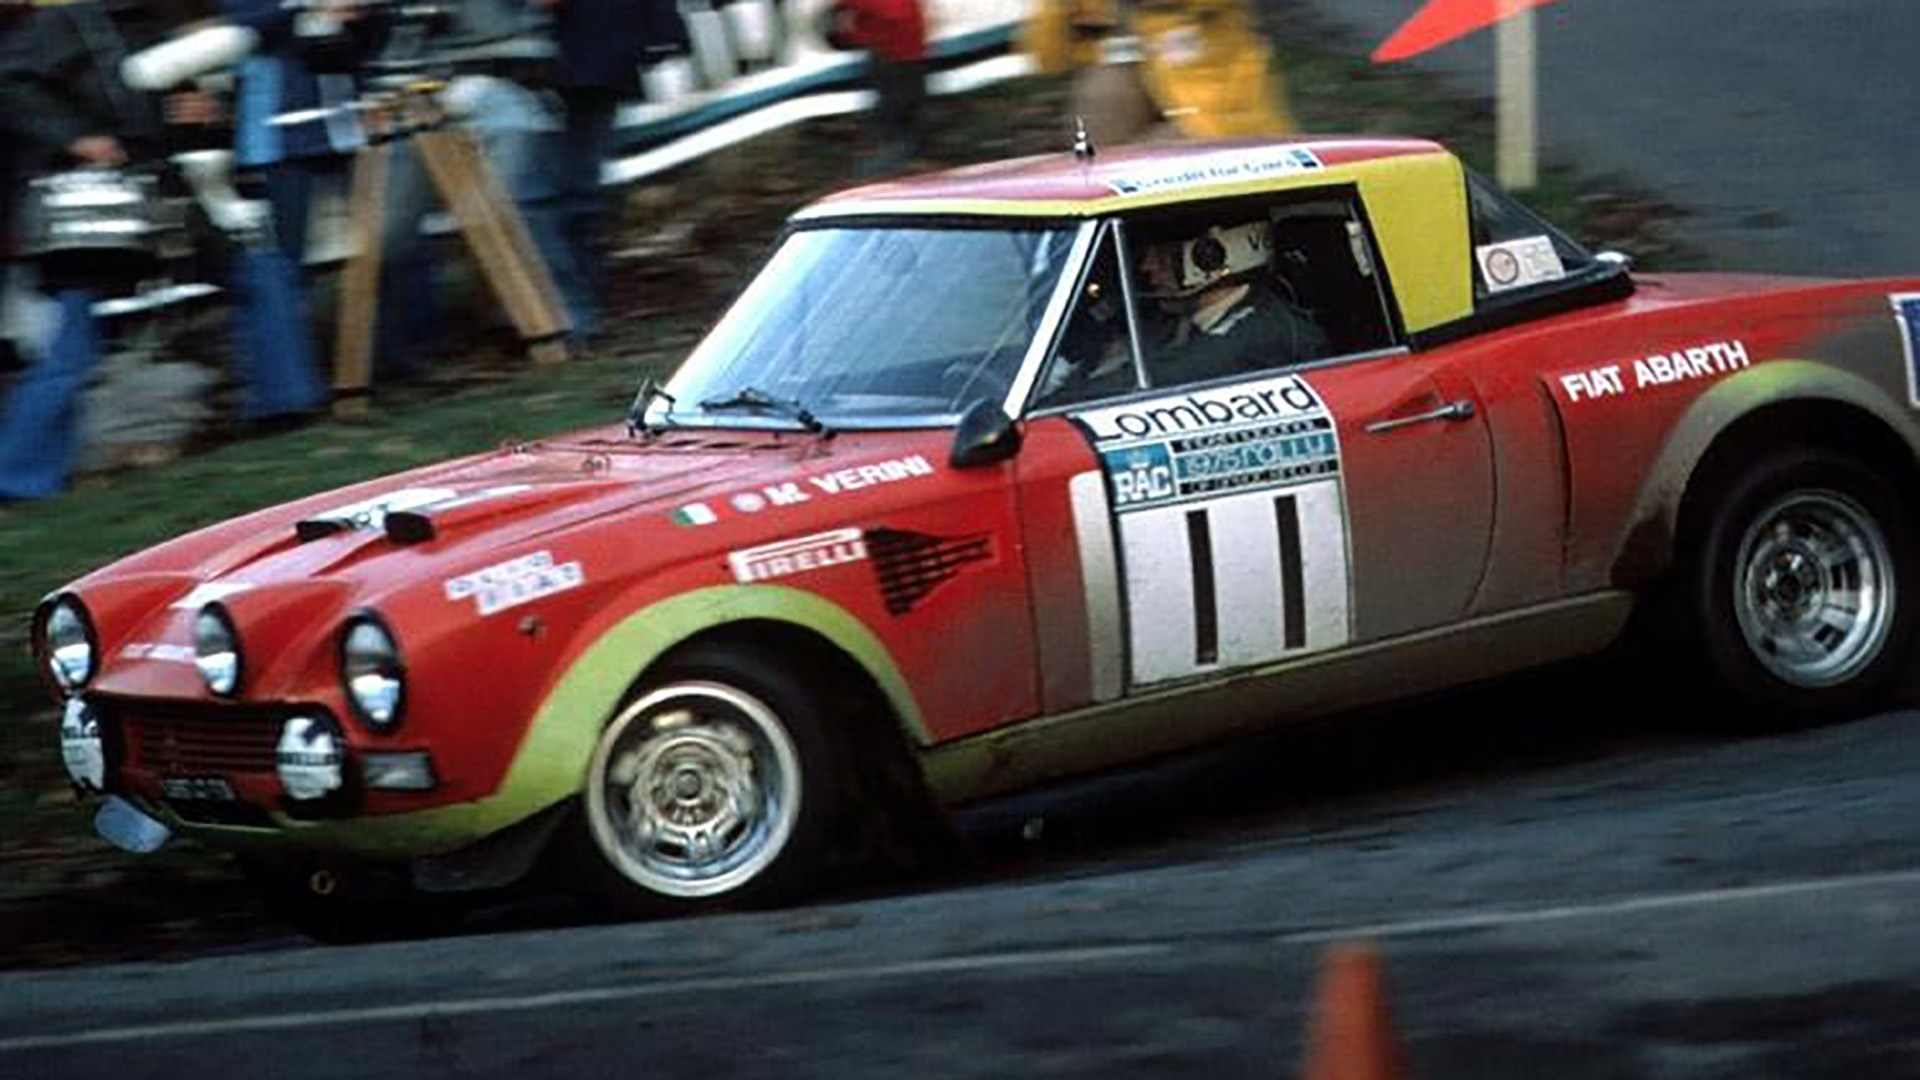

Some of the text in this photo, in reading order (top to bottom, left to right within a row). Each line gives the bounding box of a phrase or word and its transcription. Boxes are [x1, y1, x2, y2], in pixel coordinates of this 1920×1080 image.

[1560, 340, 1750, 402] FIAT ABARTH
[1092, 377, 1319, 441] Lombard
[808, 455, 934, 494] VERINI
[1113, 465, 1171, 503] RAC
[728, 528, 866, 582] PIRELLI
[1186, 494, 1306, 667] 11
